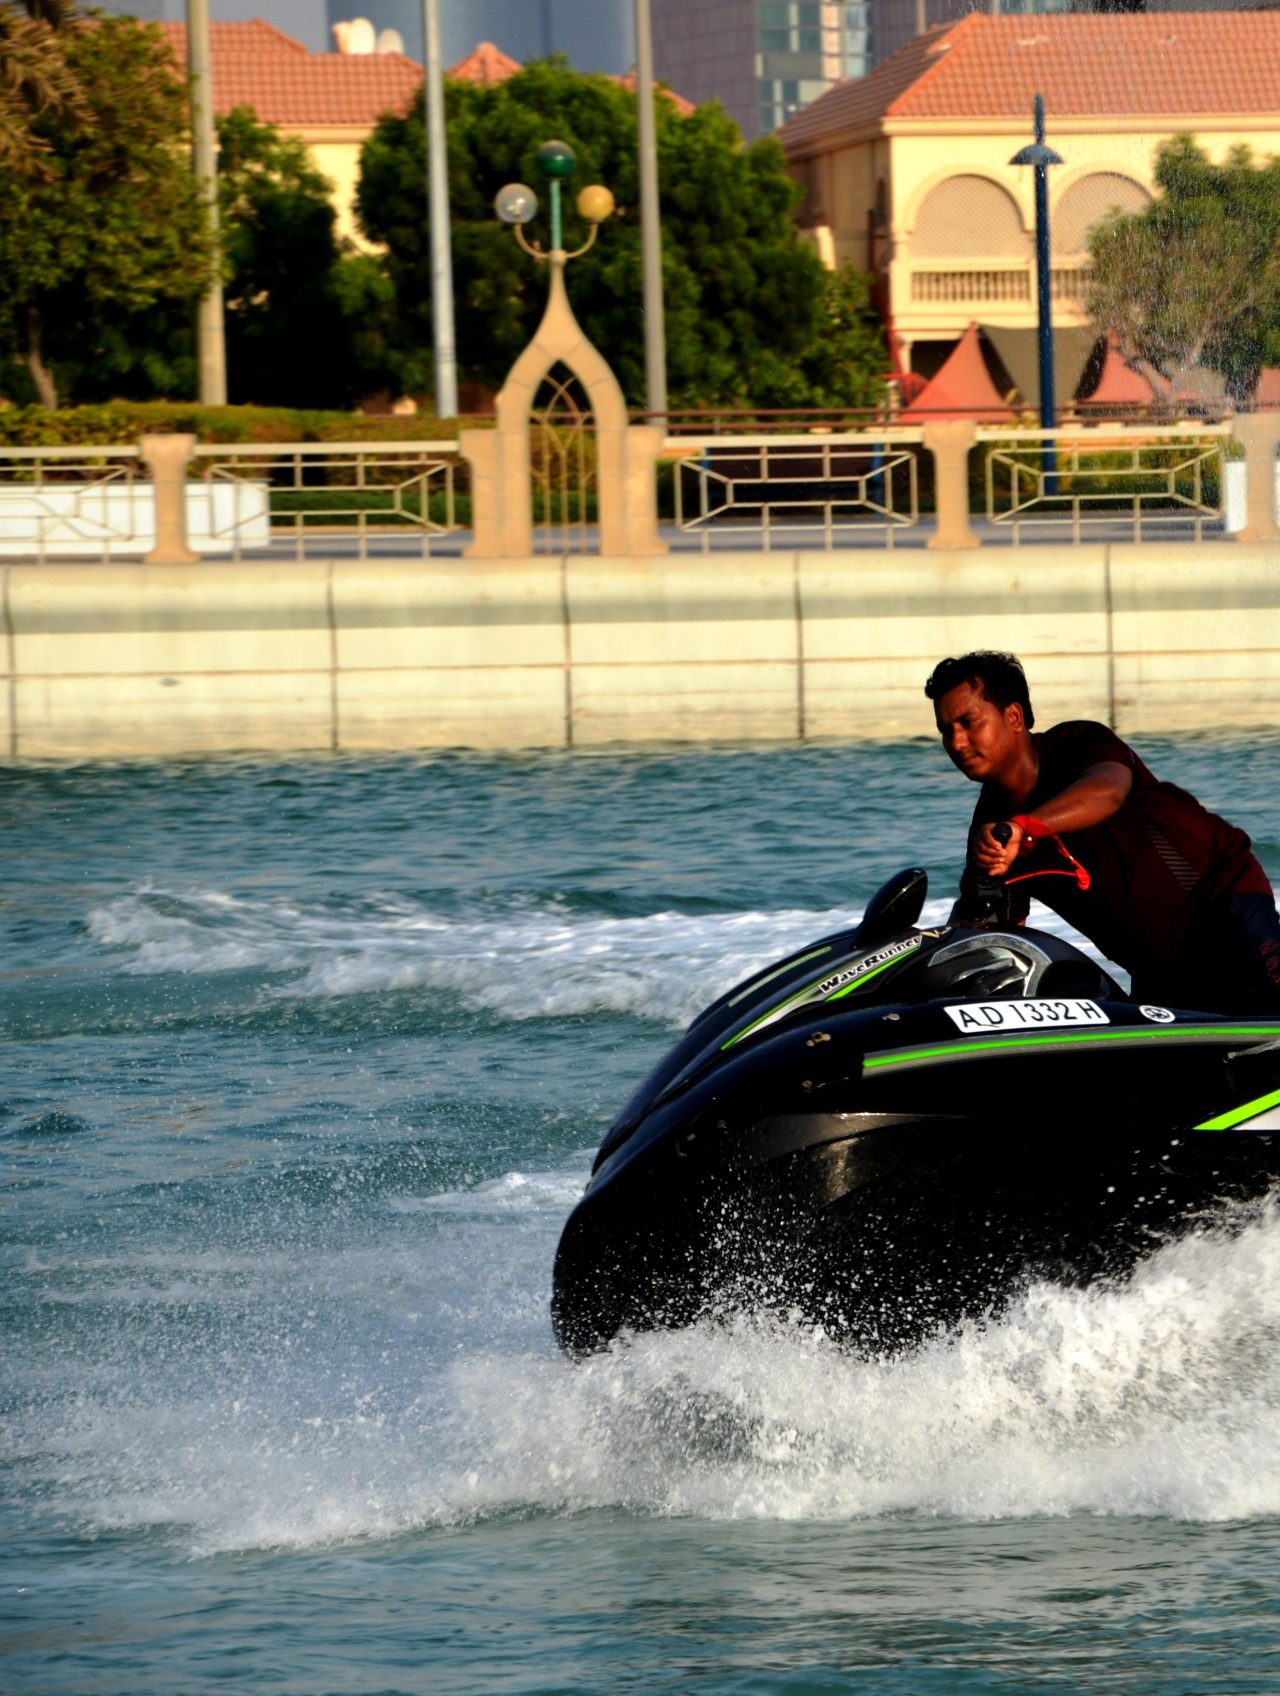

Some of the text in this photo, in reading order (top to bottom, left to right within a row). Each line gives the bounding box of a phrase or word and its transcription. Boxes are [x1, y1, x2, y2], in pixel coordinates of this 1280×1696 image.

[819, 934, 922, 994] WaveRunner
[958, 1001, 1103, 1028] AD 1332 H
